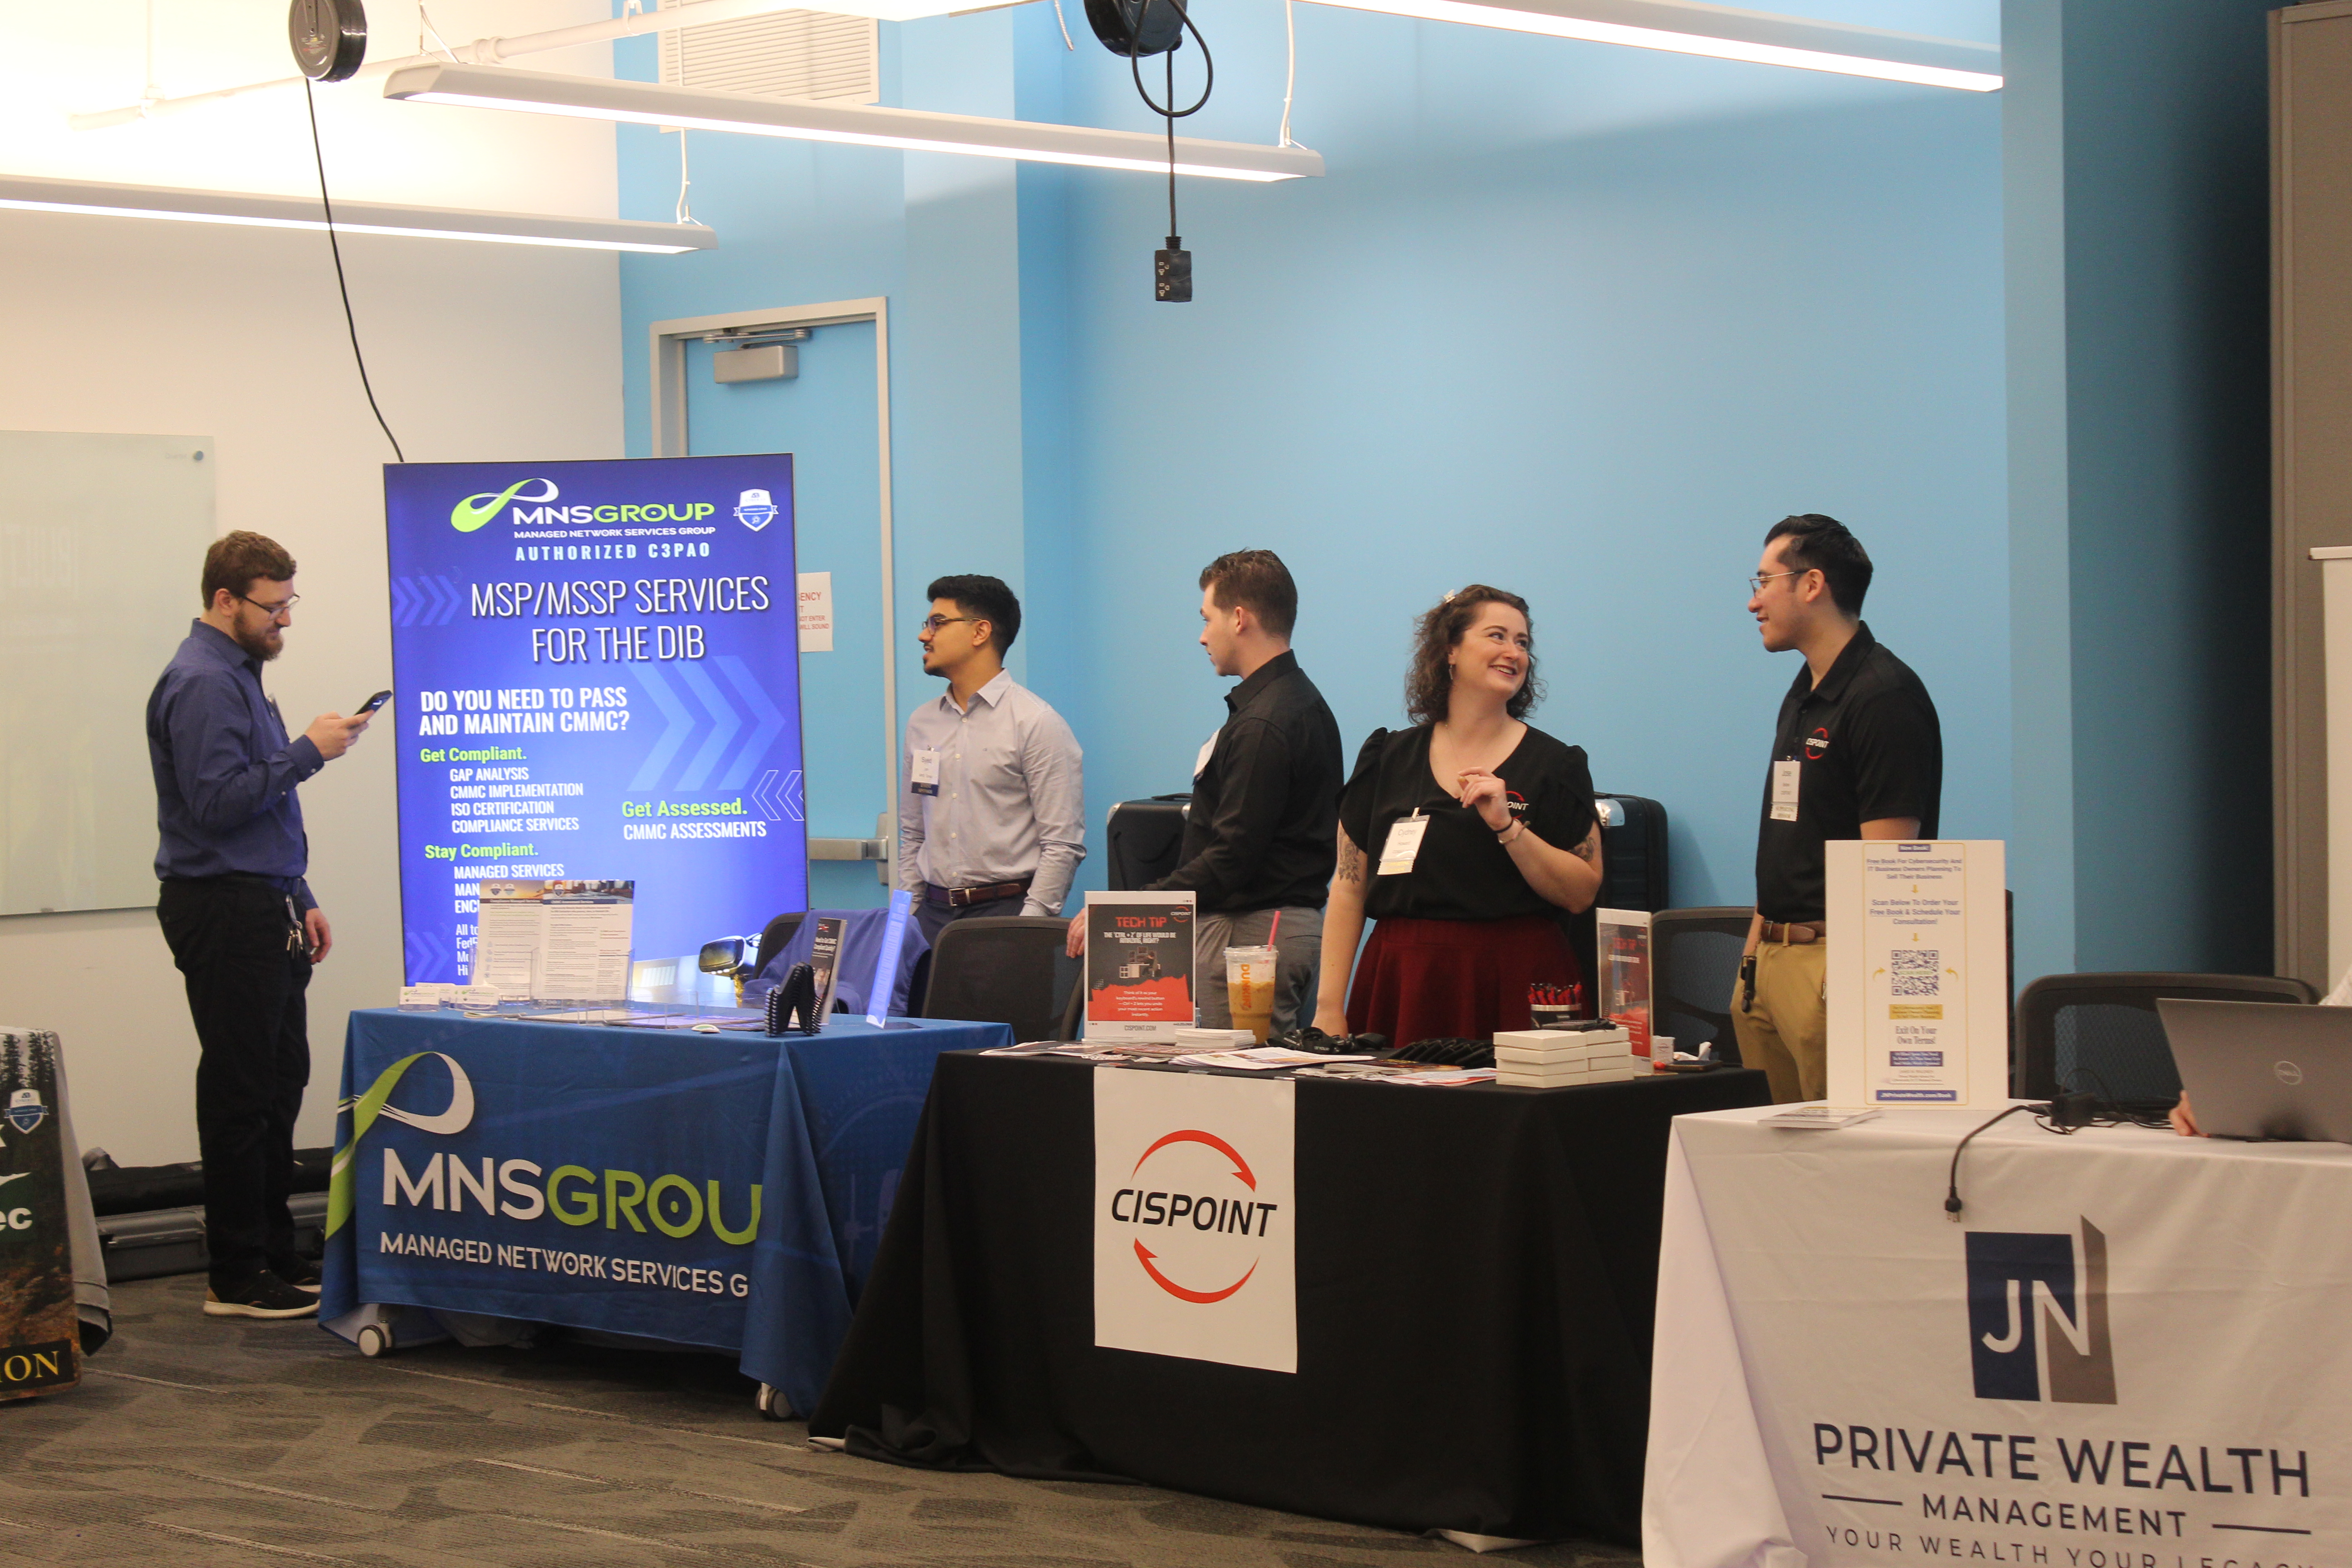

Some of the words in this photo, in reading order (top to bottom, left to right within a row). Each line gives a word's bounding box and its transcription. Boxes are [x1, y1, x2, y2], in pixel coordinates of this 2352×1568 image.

[513, 502, 715, 525] MNSGROUP
[514, 530, 568, 539] MANAGED
[569, 529, 623, 538] NETWORK
[624, 527, 676, 537] SERVICES
[678, 526, 716, 535] GROUP
[515, 544, 637, 562] AUTHORIZED
[648, 542, 711, 559] C3PAO
[471, 580, 627, 617] MSP/MSSP
[635, 576, 770, 614] SERVICES
[532, 627, 588, 662] FOR
[594, 626, 648, 661] THE
[657, 625, 705, 659] DIB
[420, 691, 448, 712] DO
[452, 690, 492, 711] YOU
[498, 688, 544, 710] NEED
[549, 688, 573, 708] TO
[579, 686, 627, 708] PASS
[419, 714, 458, 735] AND
[464, 712, 554, 734] MAINTAIN
[560, 710, 630, 732] CMMC?
[420, 748, 446, 762] Get
[448, 746, 527, 764] Compliant.
[450, 769, 474, 782] GAP
[475, 767, 529, 781] ANALYSIS
[450, 785, 486, 799] CMMC
[488, 783, 583, 798] IMPLEMENTATION
[451, 803, 470, 816] ISO
[472, 801, 554, 815] CERTIFICATION
[622, 801, 652, 818] Get
[657, 798, 748, 817] Assessed.
[451, 819, 523, 833] COMPLIANCE
[525, 817, 579, 831] SERVICES
[623, 824, 666, 840] CMMC
[670, 821, 767, 839] ASSESSMENTS
[425, 844, 457, 861] Stay
[461, 843, 539, 860] Compliant.
[454, 865, 509, 879] MANAGED
[511, 863, 564, 877] SERVICES
[456, 924, 469, 936] All
[1116, 916, 1147, 927] TECH
[1111, 1188, 1278, 1238] CISPOINT
[380, 1231, 492, 1264] MANAGED
[497, 1243, 607, 1279] NETWORK
[611, 1258, 724, 1295] SERVICES
[729, 1273, 749, 1297] G
[1981, 1279, 2092, 1357] JN
[1813, 1422, 2040, 1481] PRIVATE
[2056, 1436, 2311, 1497] WEALTH
[1921, 1493, 2187, 1537] MANAGEMENT
[1826, 1525, 1904, 1552] YOUR
[1919, 1534, 2049, 1564] WEALTH
[2067, 1546, 2156, 1568] YOUR
